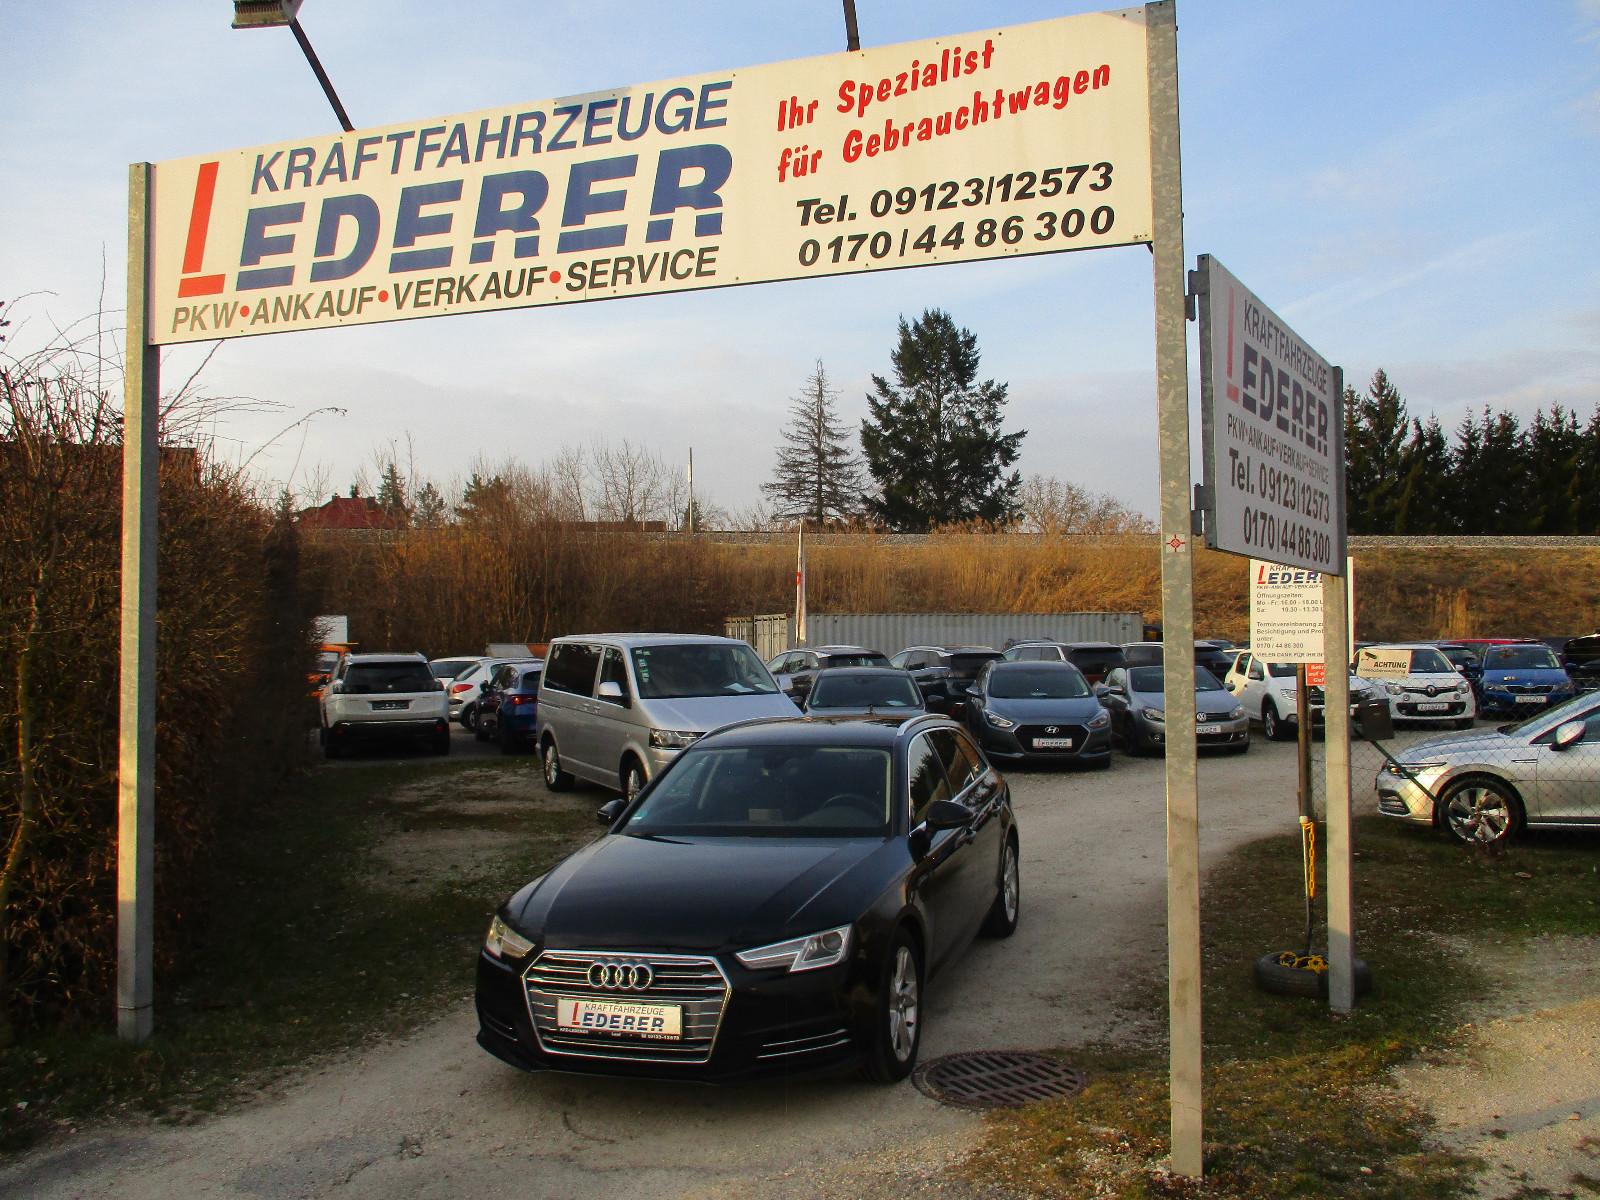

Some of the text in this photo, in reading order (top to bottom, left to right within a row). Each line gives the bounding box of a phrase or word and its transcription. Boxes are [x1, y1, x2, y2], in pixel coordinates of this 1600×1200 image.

[776, 39, 995, 131] Ihr Spezialist
[777, 64, 1111, 183] für Gebrauchtwagen
[250, 81, 733, 195] KRAFTFAHRZEUGE
[177, 144, 733, 298] LEDERER
[796, 195, 857, 226] Tel.
[171, 246, 720, 333] PKW ANKAUF VERKAUF SERVICE
[1226, 286, 1329, 457] LEDERER
[1244, 299, 1328, 396] KRAFTFAHRZEUGE
[1227, 413, 1246, 443] PKW
[1248, 426, 1276, 458] ANKAUF
[1229, 447, 1255, 494] Tel.
[1373, 661, 1407, 669] ACHTUNG
[572, 1002, 665, 1032] LEDERER
[584, 1003, 665, 1016] KRAFTFAHRZEUGE
